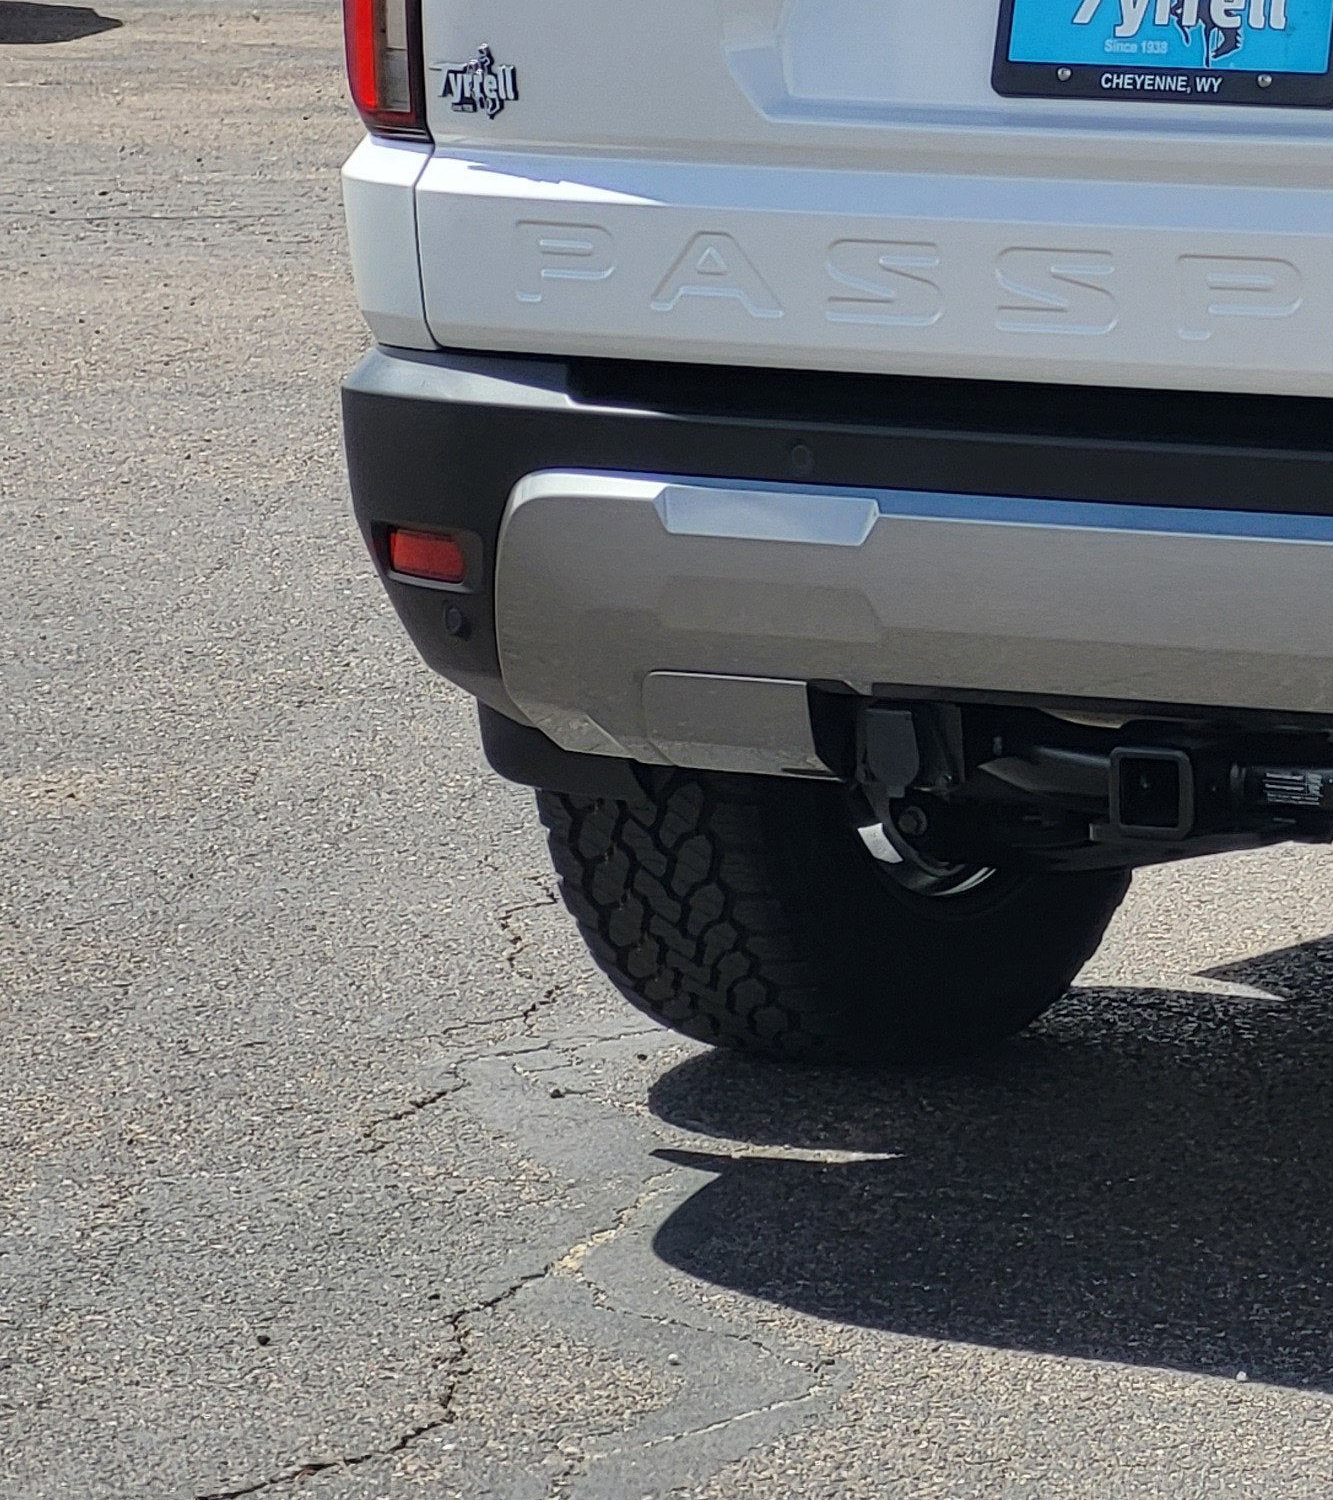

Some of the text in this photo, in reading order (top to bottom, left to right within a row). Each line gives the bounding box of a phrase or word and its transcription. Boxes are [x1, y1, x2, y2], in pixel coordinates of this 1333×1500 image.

[1103, 39, 1168, 55] Since 1938
[429, 61, 517, 104] Tyrrell
[1101, 73, 1222, 93] CHEYENNE, WY
